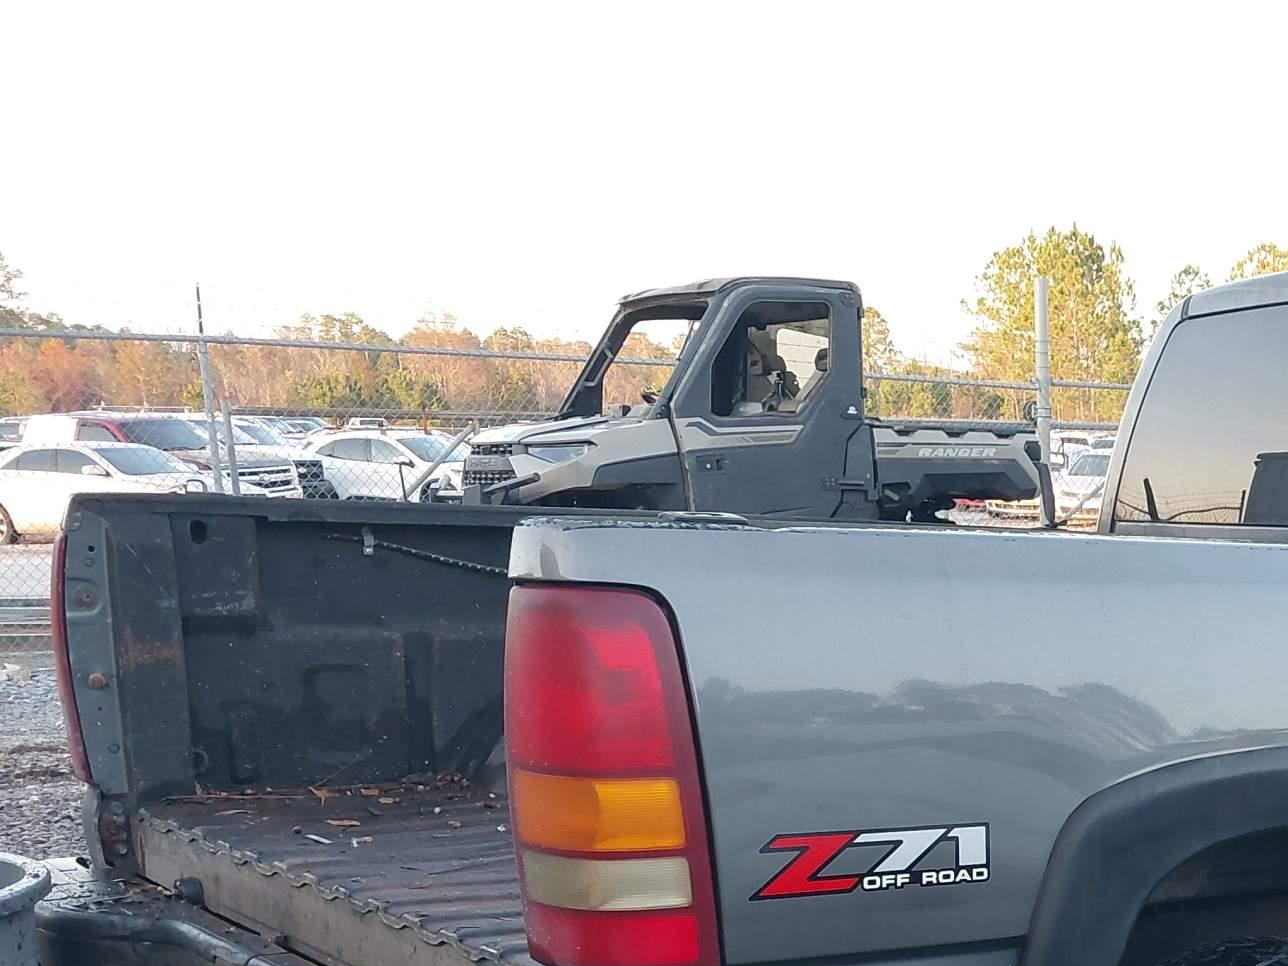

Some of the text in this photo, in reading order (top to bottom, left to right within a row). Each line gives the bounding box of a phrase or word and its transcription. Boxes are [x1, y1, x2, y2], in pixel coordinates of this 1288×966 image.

[918, 447, 996, 457] RANGER
[753, 824, 989, 898] Z71
[862, 867, 988, 890] OFF ROAD
